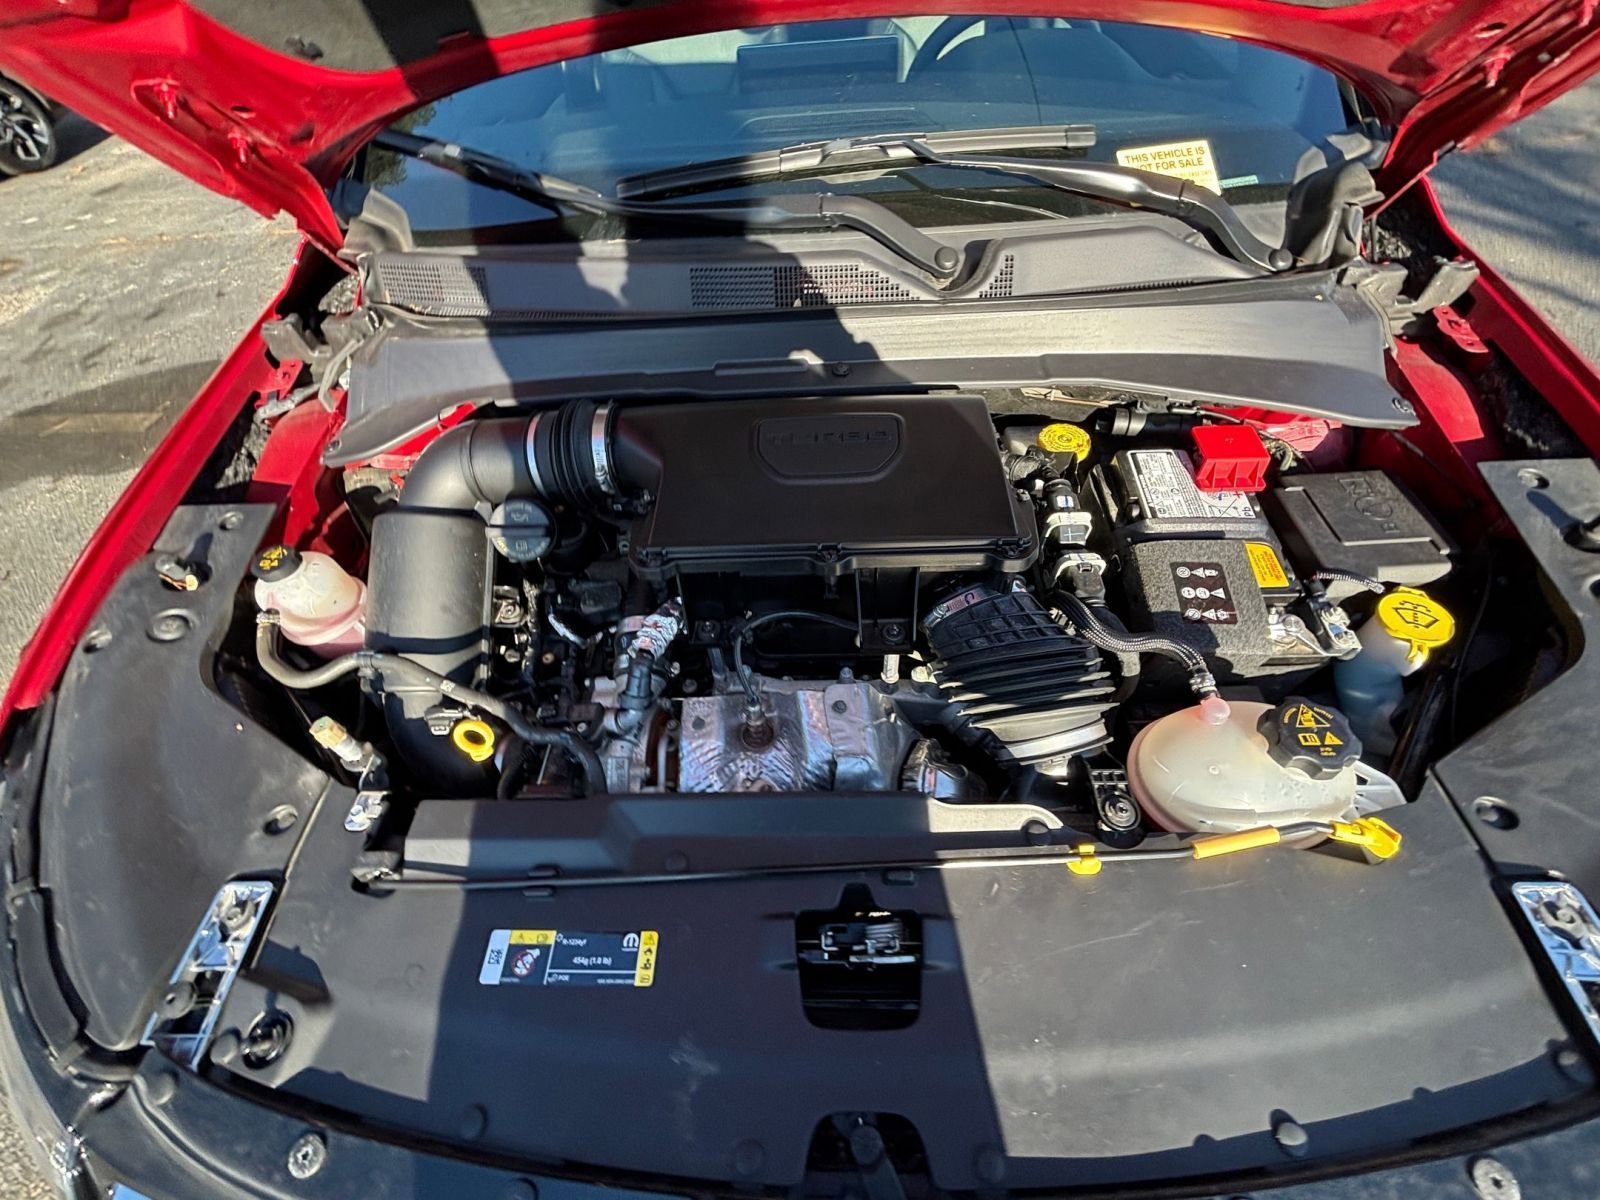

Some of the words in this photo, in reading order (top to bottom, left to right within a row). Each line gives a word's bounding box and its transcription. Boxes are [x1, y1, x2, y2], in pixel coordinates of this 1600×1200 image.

[1125, 154, 1148, 164] THIS
[1150, 148, 1192, 160] VEHICLE
[1195, 146, 1205, 156] IS
[1156, 160, 1176, 171] FOR
[1178, 157, 1204, 168] SALE
[1242, 506, 1253, 517] Pb
